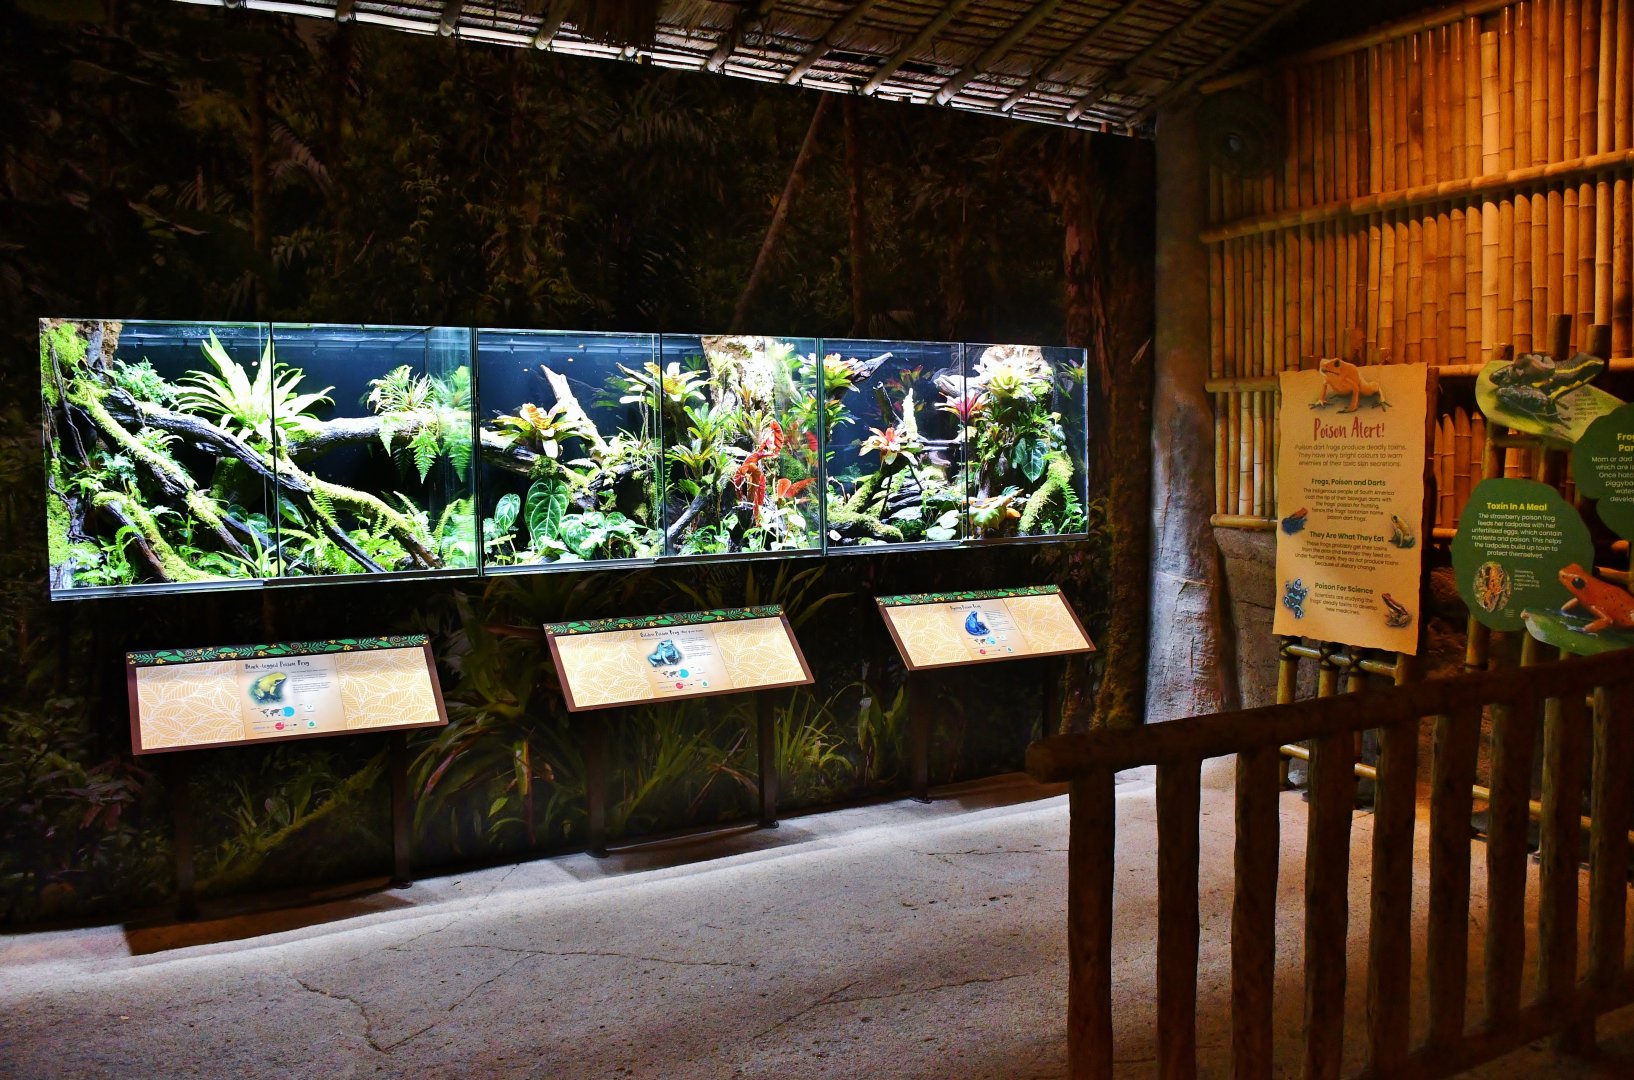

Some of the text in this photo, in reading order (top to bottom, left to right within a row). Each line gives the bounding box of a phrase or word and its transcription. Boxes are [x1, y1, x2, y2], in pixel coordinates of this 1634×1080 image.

[1314, 416, 1385, 441] Poison Alert!
[1617, 433, 1634, 442] Fro
[1326, 444, 1340, 452] frogs
[1342, 444, 1365, 452] produce
[1366, 444, 1386, 452] deadly
[1312, 478, 1330, 486] Frogs,
[1487, 502, 1508, 510] Toxin
[1526, 503, 1547, 511] Meal
[1542, 514, 1556, 522] frog
[1310, 531, 1324, 539] They
[1338, 532, 1355, 540] What
[1356, 534, 1372, 542] They
[1332, 542, 1352, 550] probably
[1315, 582, 1373, 594] Poison For Science
[1323, 599, 1338, 607] deadly
